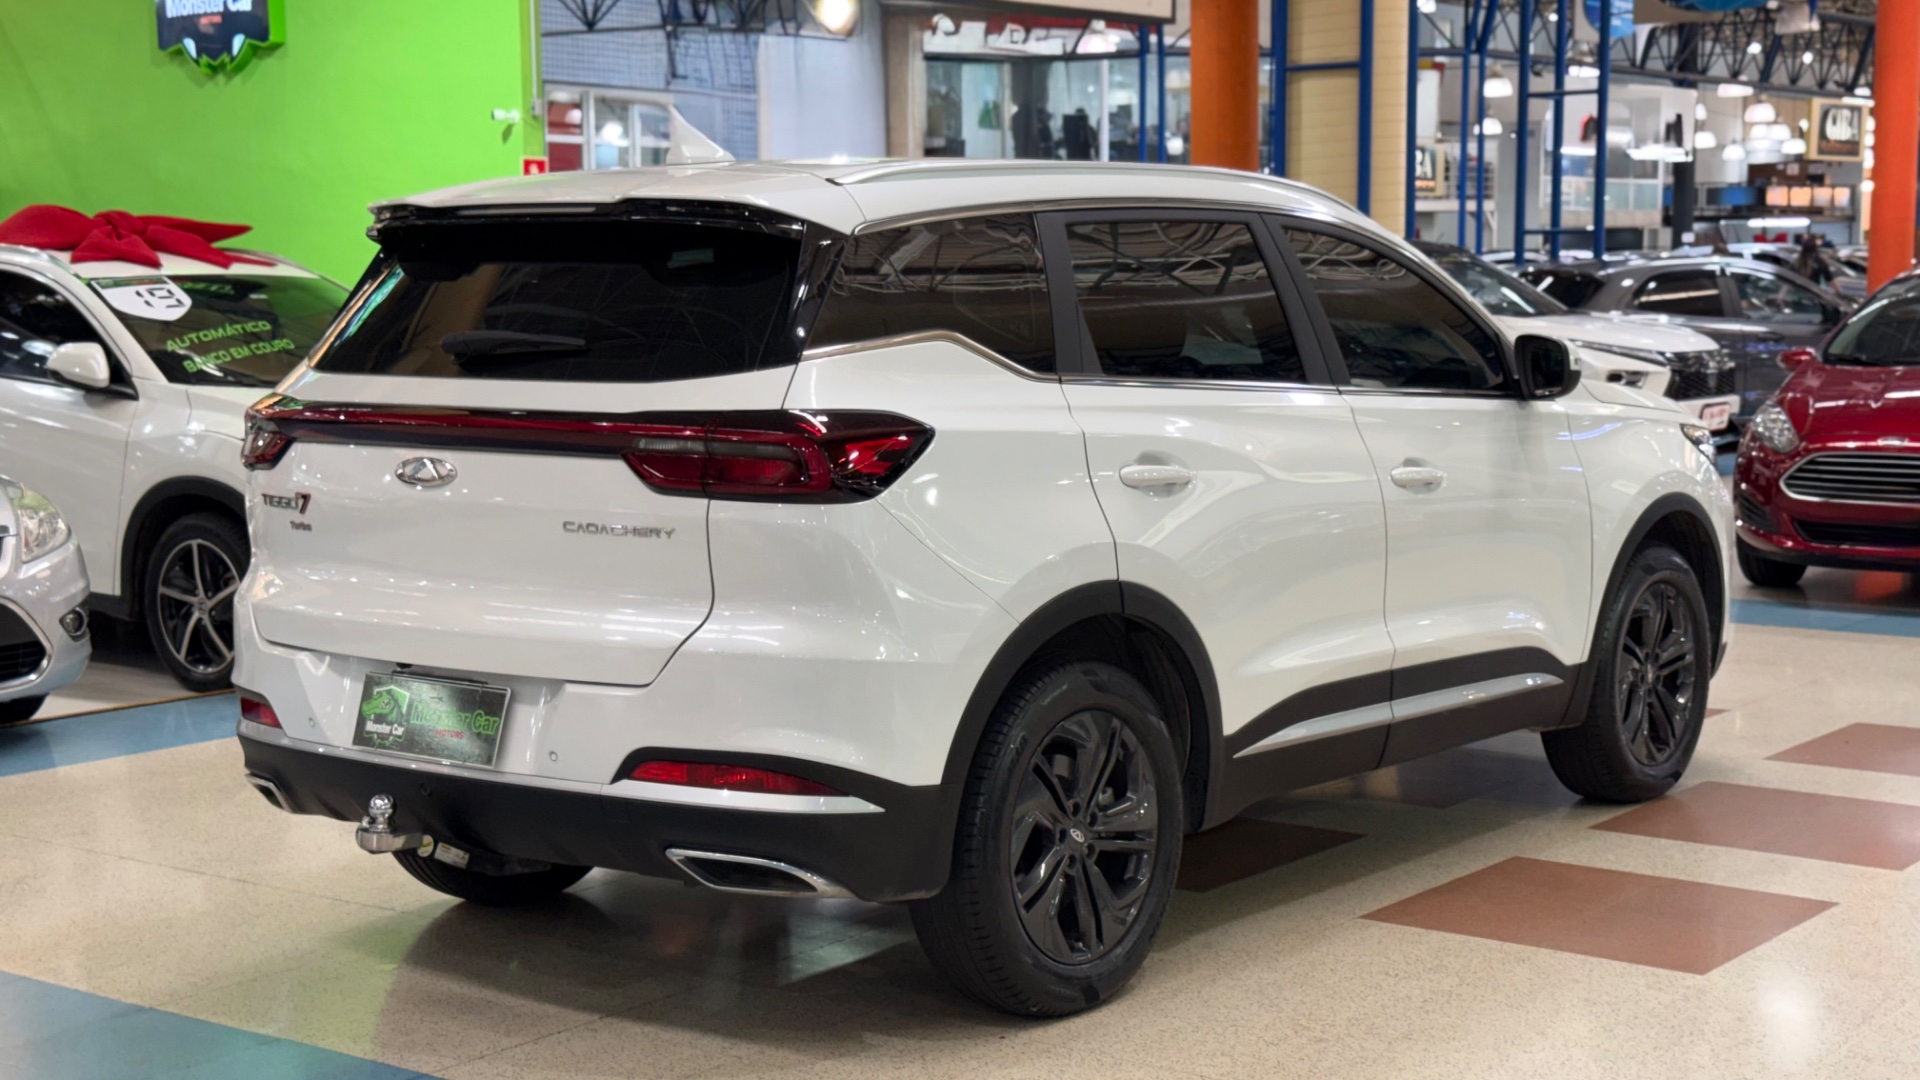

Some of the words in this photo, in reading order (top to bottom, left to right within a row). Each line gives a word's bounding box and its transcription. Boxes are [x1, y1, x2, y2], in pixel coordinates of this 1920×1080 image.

[166, 321, 271, 352] AUTOMÁTICO
[182, 350, 232, 373] BANCO
[229, 345, 252, 359] EM
[250, 339, 295, 354] COURO
[472, 710, 500, 735] Car
